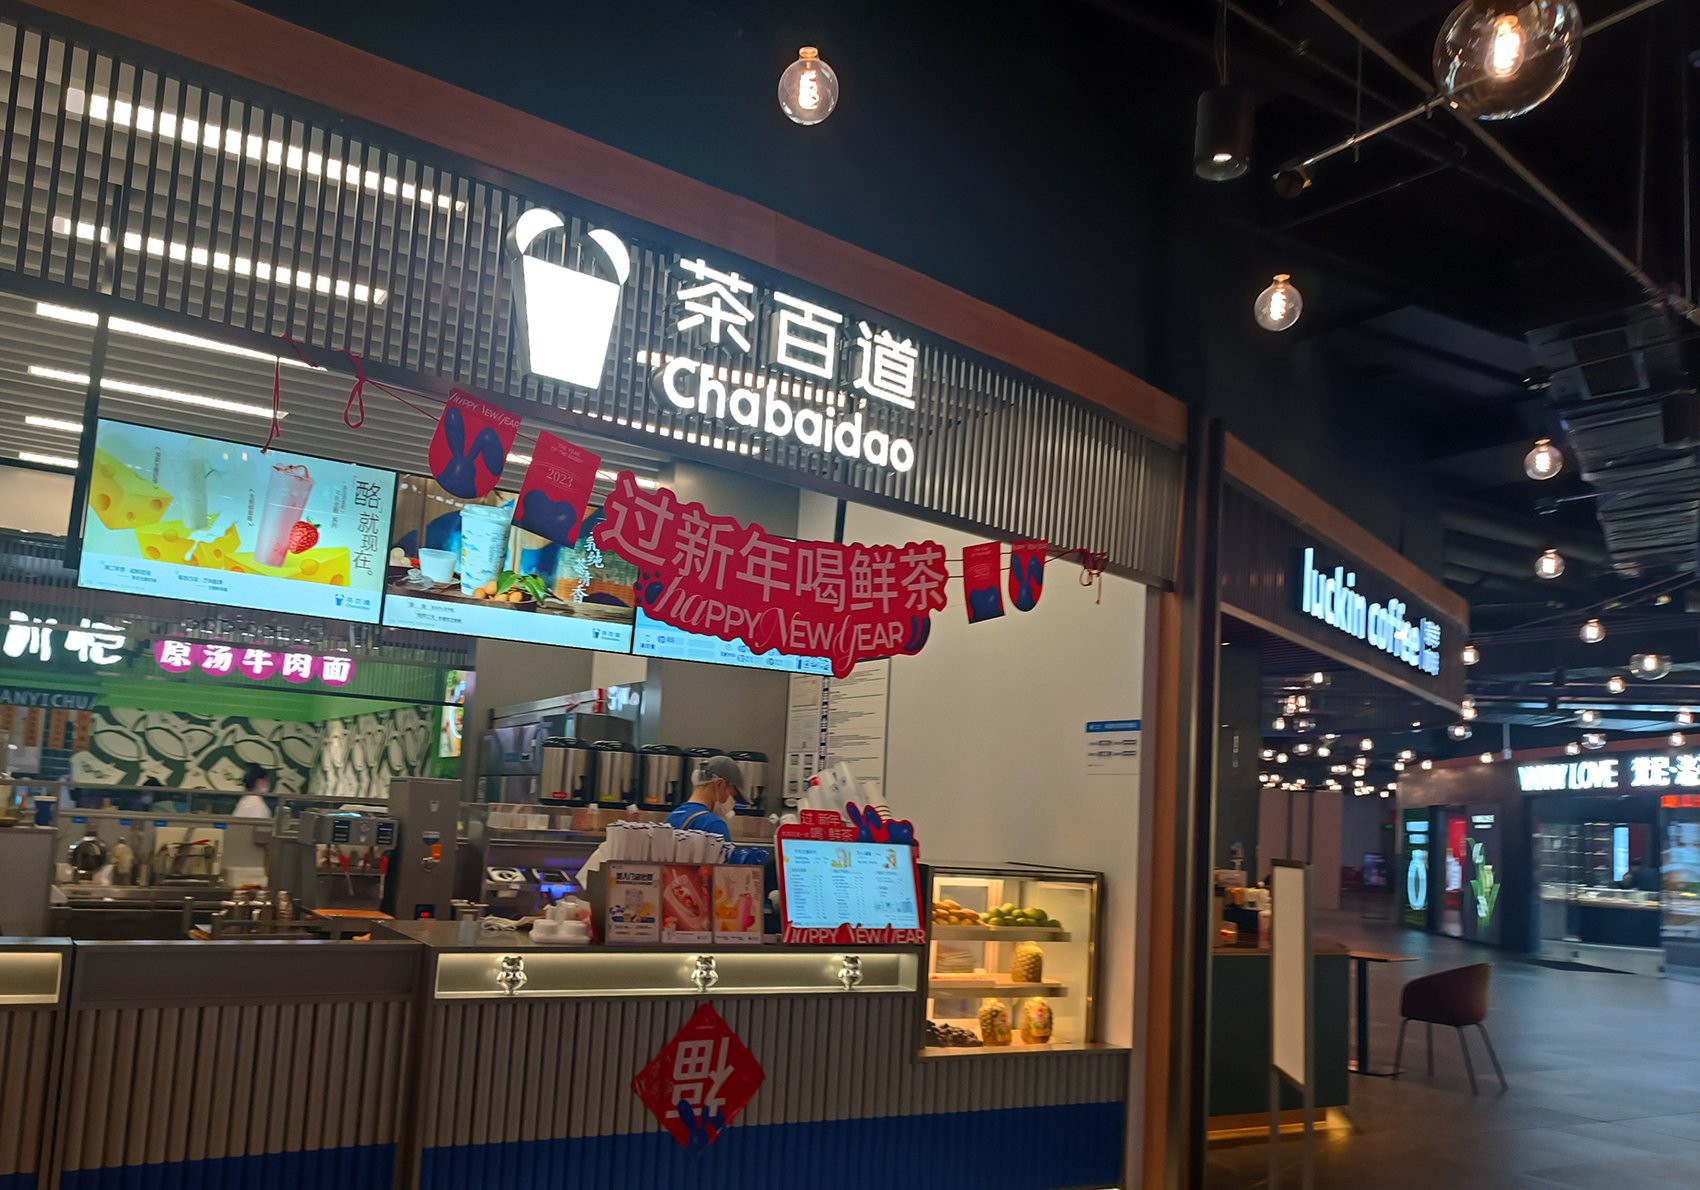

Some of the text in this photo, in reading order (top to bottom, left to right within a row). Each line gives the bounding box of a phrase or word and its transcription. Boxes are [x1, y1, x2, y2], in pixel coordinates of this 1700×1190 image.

[677, 258, 918, 410] 茶百道
[663, 357, 915, 473] Chabaidao
[546, 468, 574, 488] 2023
[601, 478, 946, 614] 过新年喝鲜茶
[1302, 547, 1367, 639] luckin
[160, 640, 352, 683] 原汤牛肉面
[665, 1036, 734, 1119] 福
